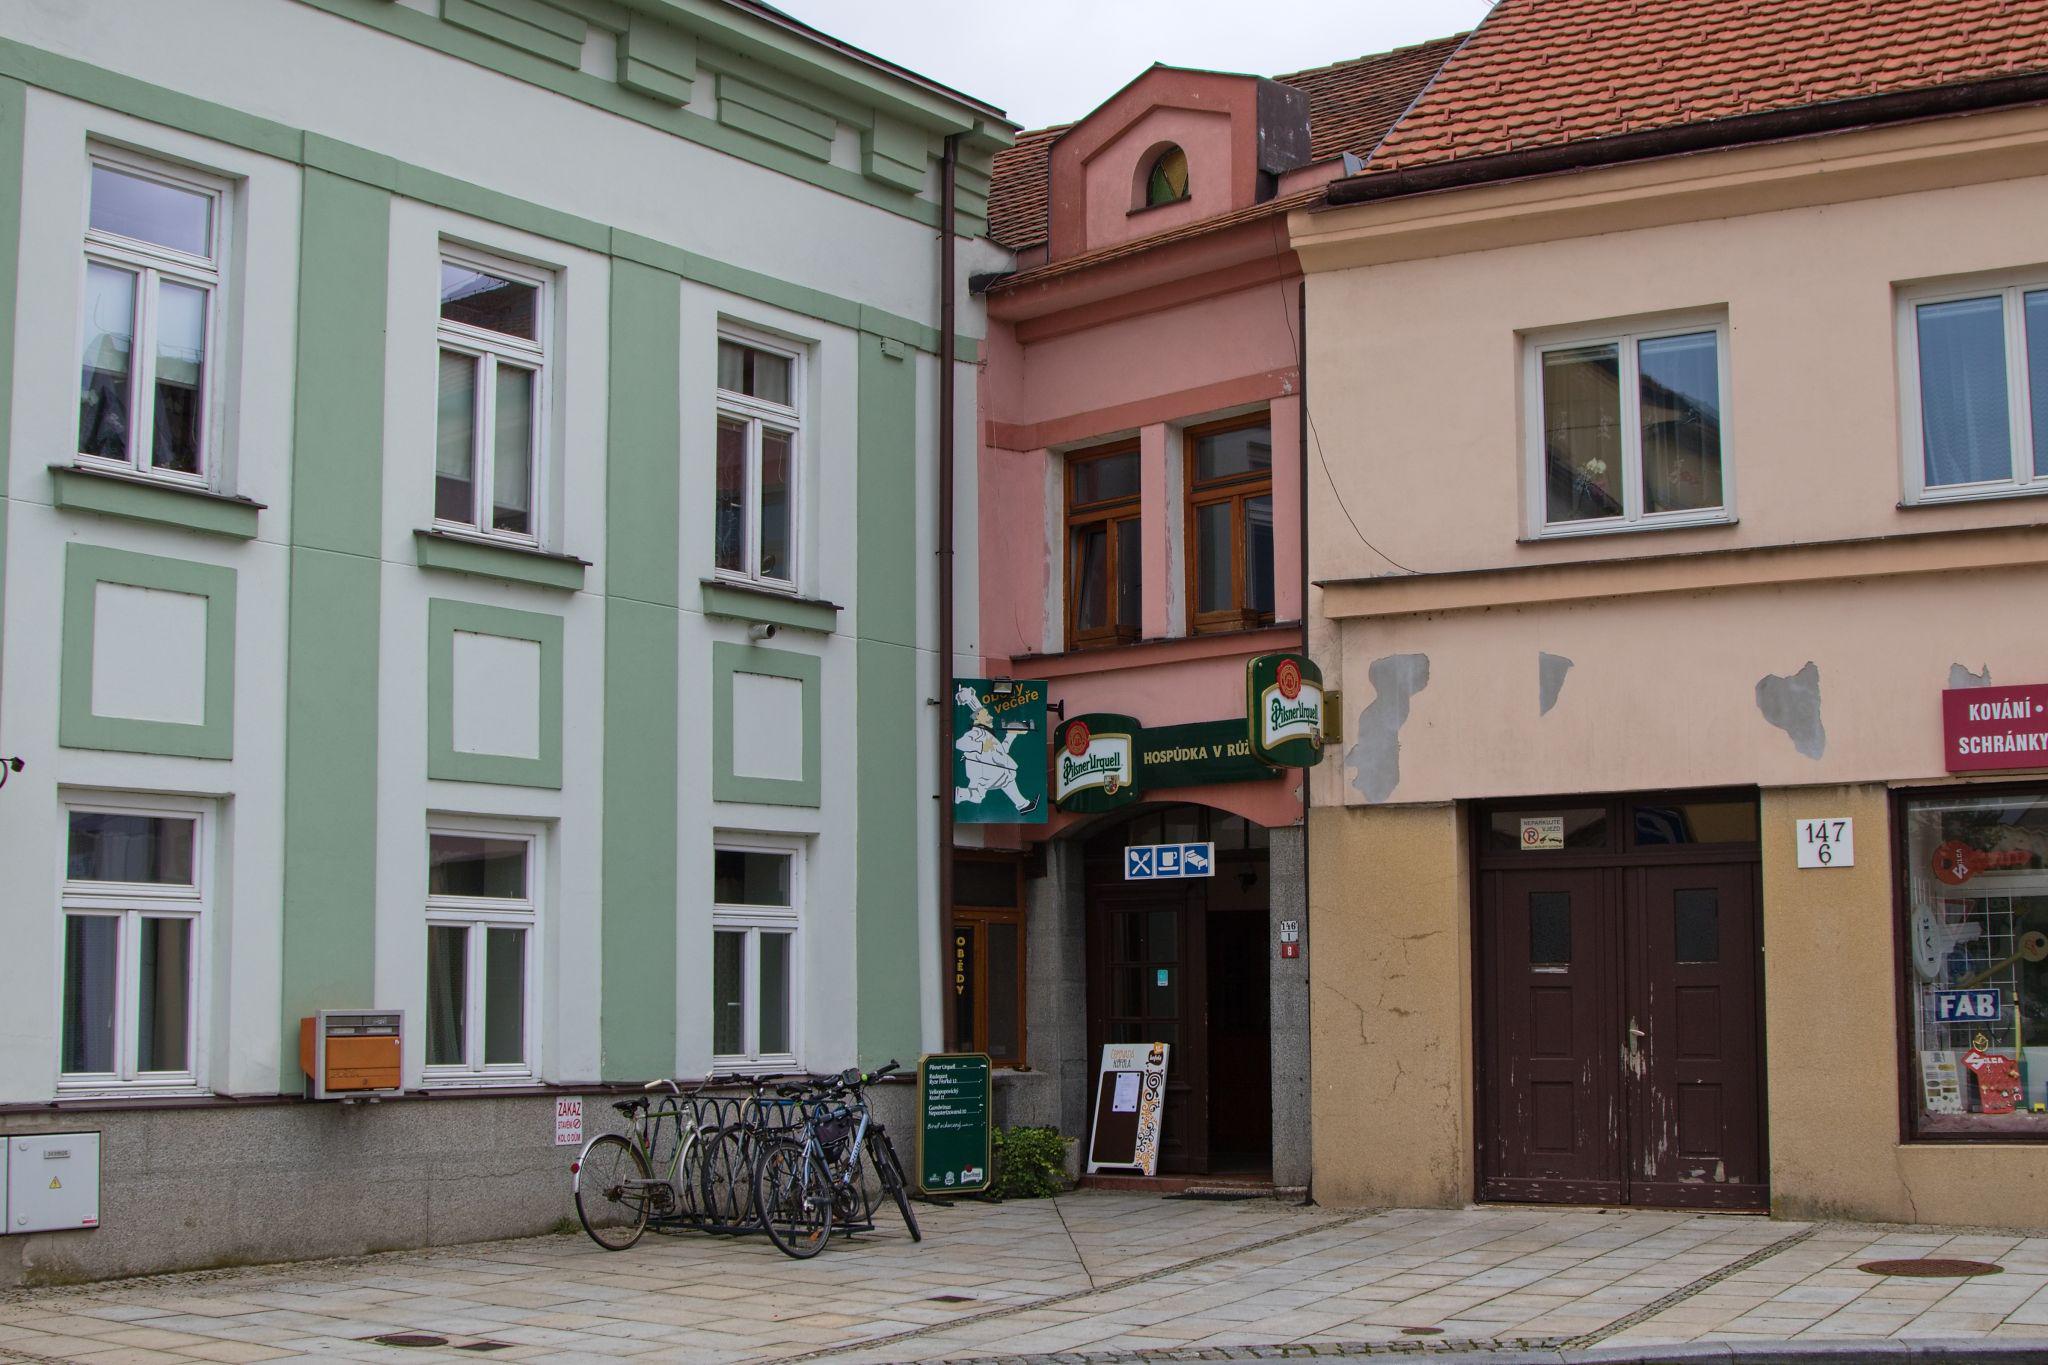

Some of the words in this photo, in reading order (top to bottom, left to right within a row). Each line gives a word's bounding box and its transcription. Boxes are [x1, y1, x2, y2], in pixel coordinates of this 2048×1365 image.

[994, 689, 1039, 714] večeře
[1969, 696, 2031, 721] KOVÁNÍ
[1271, 698, 1300, 731] Pilsner
[1298, 701, 1319, 726] Urquell
[1143, 746, 1208, 765] HOSPŮDKA
[1213, 744, 1223, 758] V
[1958, 730, 2048, 755] SCHRÁNKY
[1063, 756, 1090, 786] Pilsner
[1089, 752, 1120, 774] Urquell
[1805, 820, 1846, 843] 147
[1818, 843, 1832, 866] 6
[1281, 921, 1296, 931] 146
[1287, 946, 1292, 956] 8
[955, 936, 966, 995] OBĚDY
[1940, 994, 1995, 1019] FAB
[558, 1099, 581, 1117] ZÁKAZ
